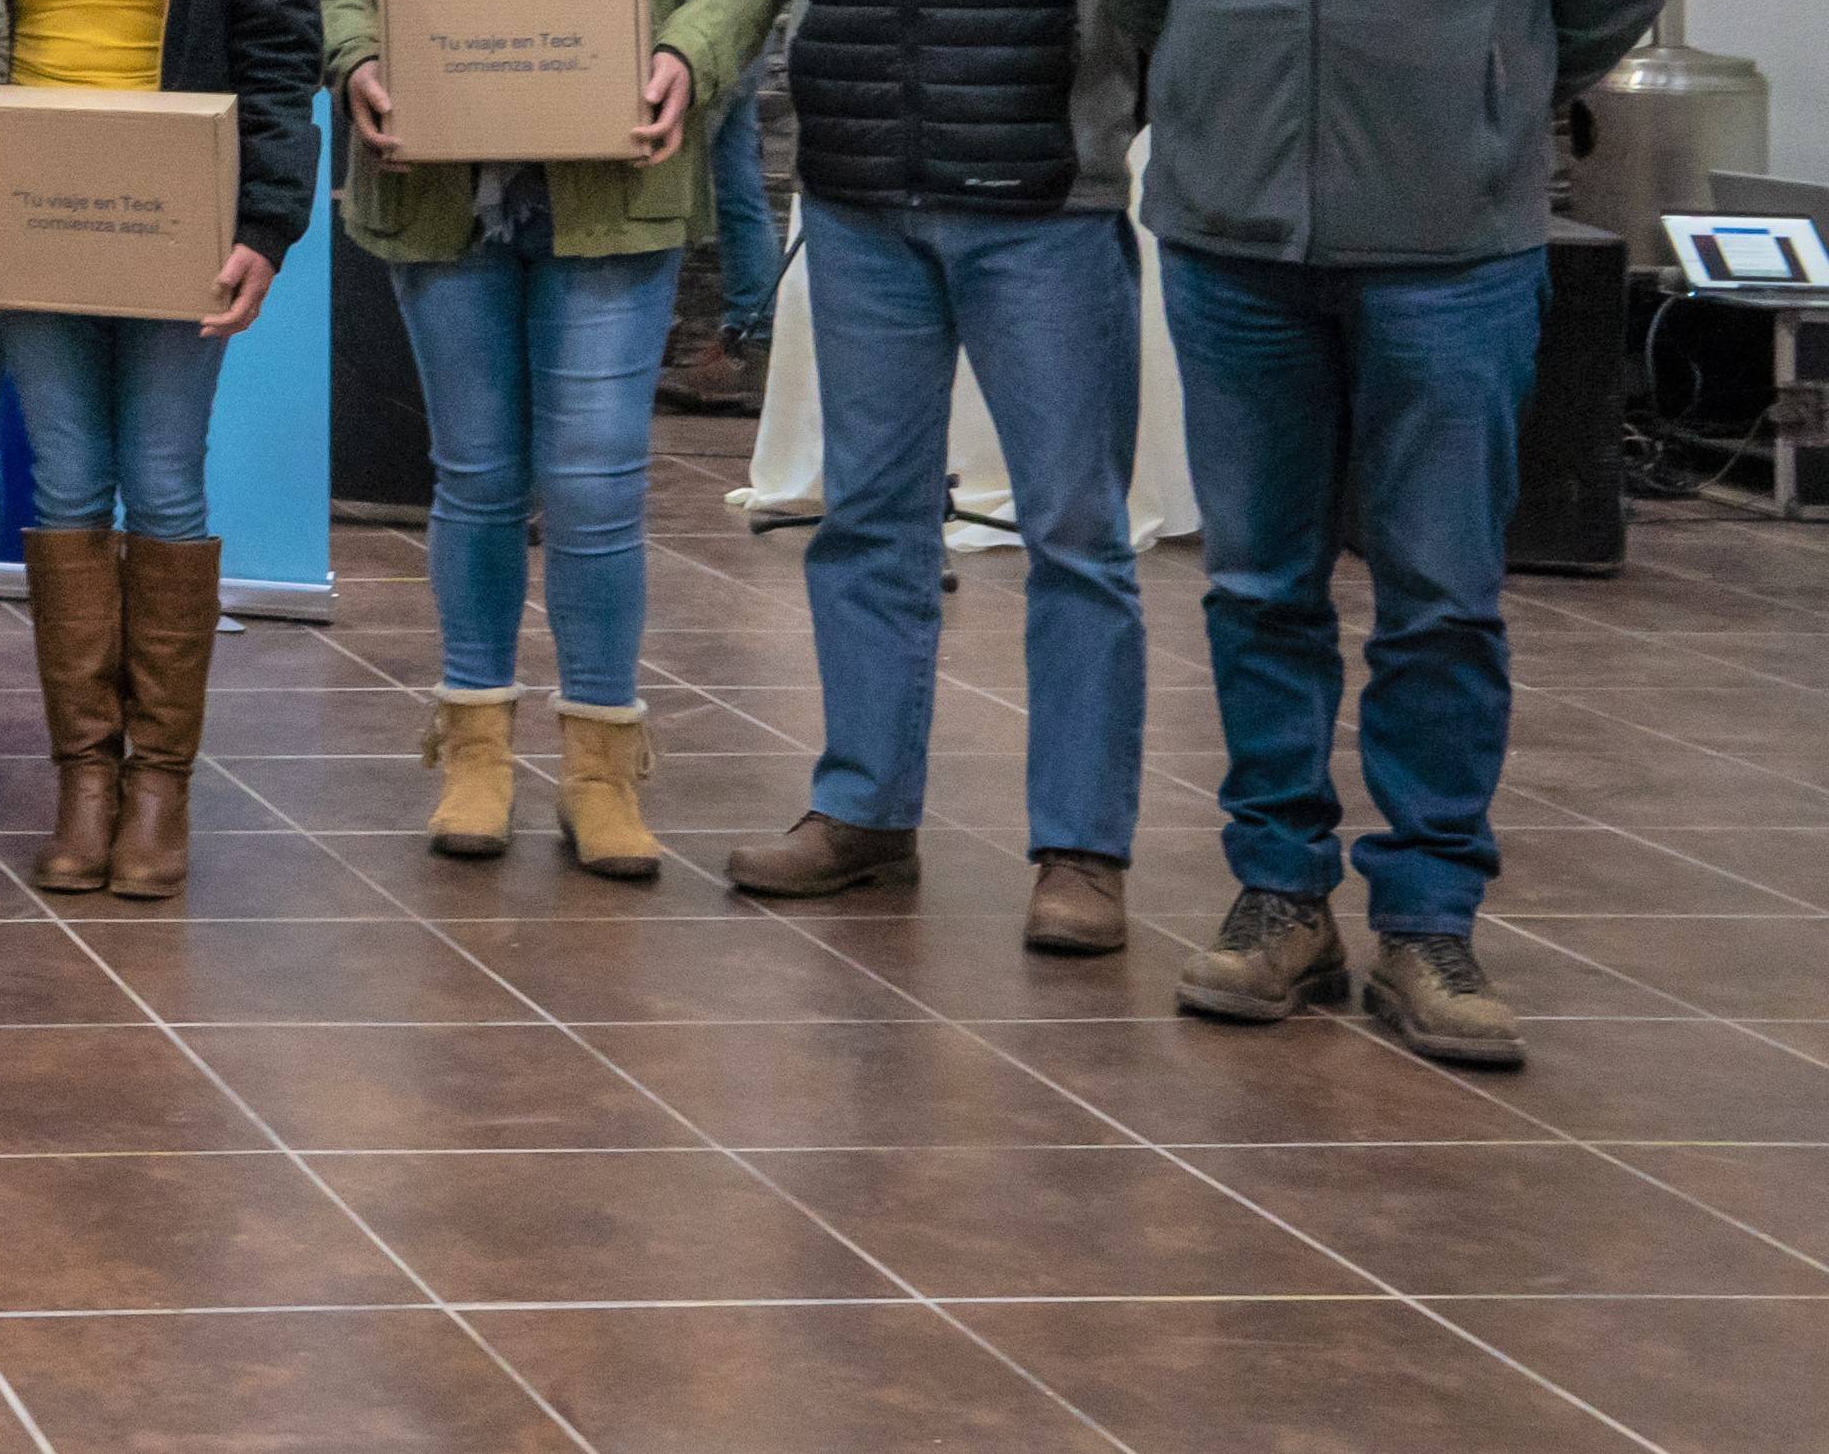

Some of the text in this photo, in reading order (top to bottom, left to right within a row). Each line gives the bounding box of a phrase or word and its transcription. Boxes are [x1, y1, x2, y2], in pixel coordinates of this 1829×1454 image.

[464, 35, 507, 54] viaje
[510, 38, 535, 50] en
[539, 33, 583, 49] Teck
[443, 58, 535, 74] comienza
